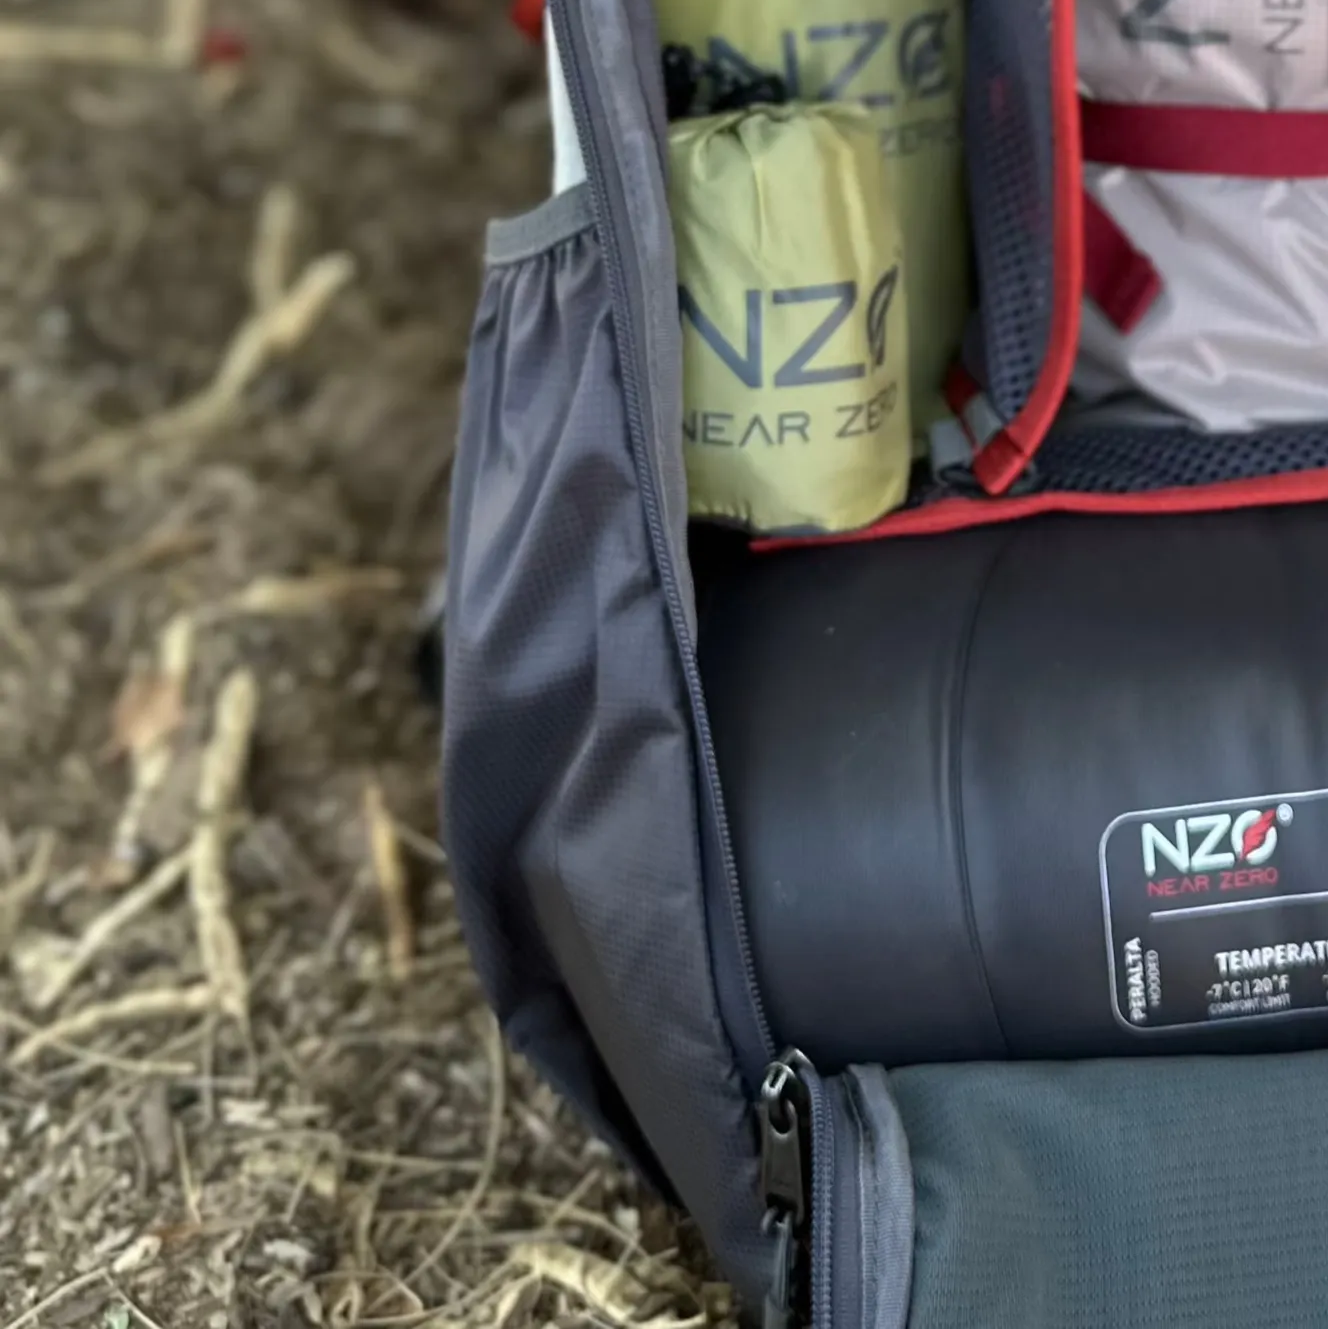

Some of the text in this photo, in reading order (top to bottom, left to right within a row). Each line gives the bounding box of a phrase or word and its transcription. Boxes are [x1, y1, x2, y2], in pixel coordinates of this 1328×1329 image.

[1147, 866, 1279, 897] NEAR ZERO
[1124, 937, 1147, 1024] PERALTA
[1144, 949, 1162, 1009] HOODED
